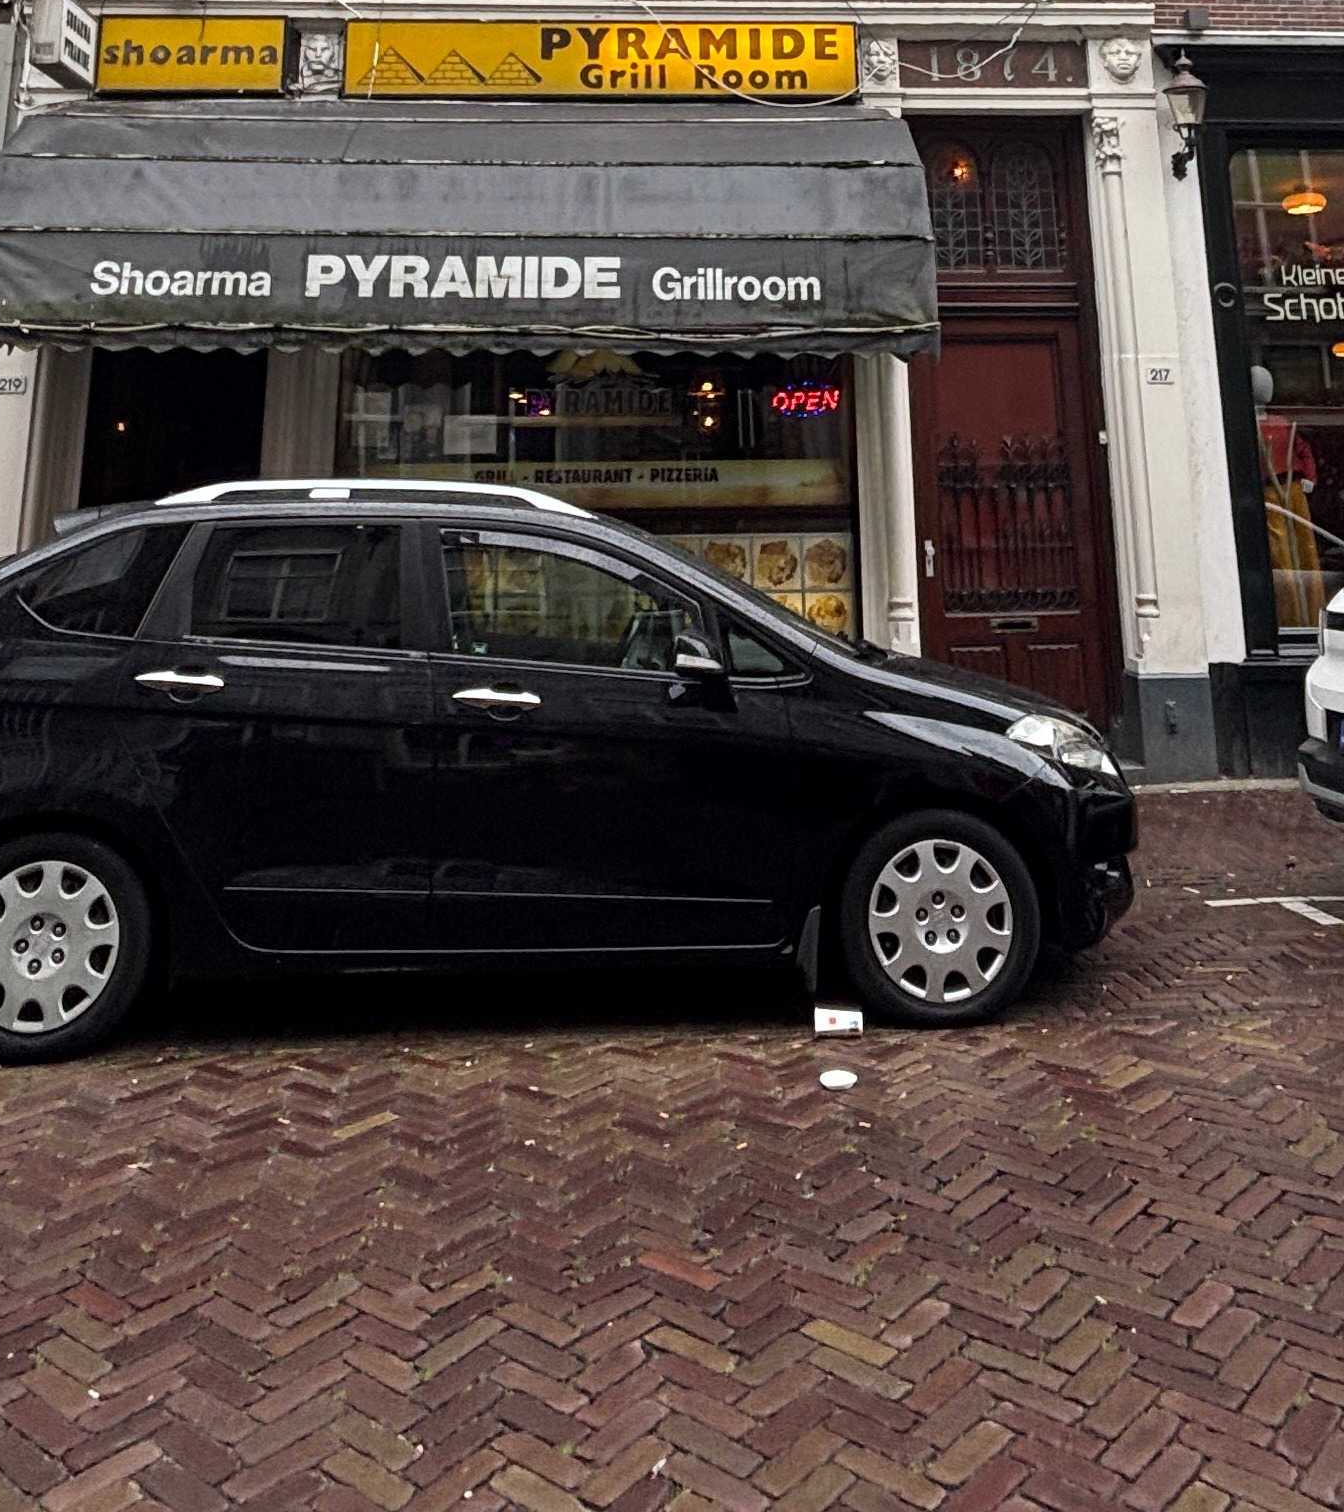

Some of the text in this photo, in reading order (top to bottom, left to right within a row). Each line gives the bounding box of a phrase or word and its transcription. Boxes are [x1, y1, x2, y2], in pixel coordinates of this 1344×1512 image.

[104, 39, 278, 66] shoarma
[540, 27, 839, 61] PYRAMIDE
[579, 62, 809, 90] Grill Room
[90, 254, 822, 302] Shoarma PYRAMIDE Grillroom
[1150, 368, 1170, 381] 217
[772, 390, 840, 413] OPEN
[534, 468, 633, 484] RESTAURANT
[650, 466, 720, 483] PIZZERIA
